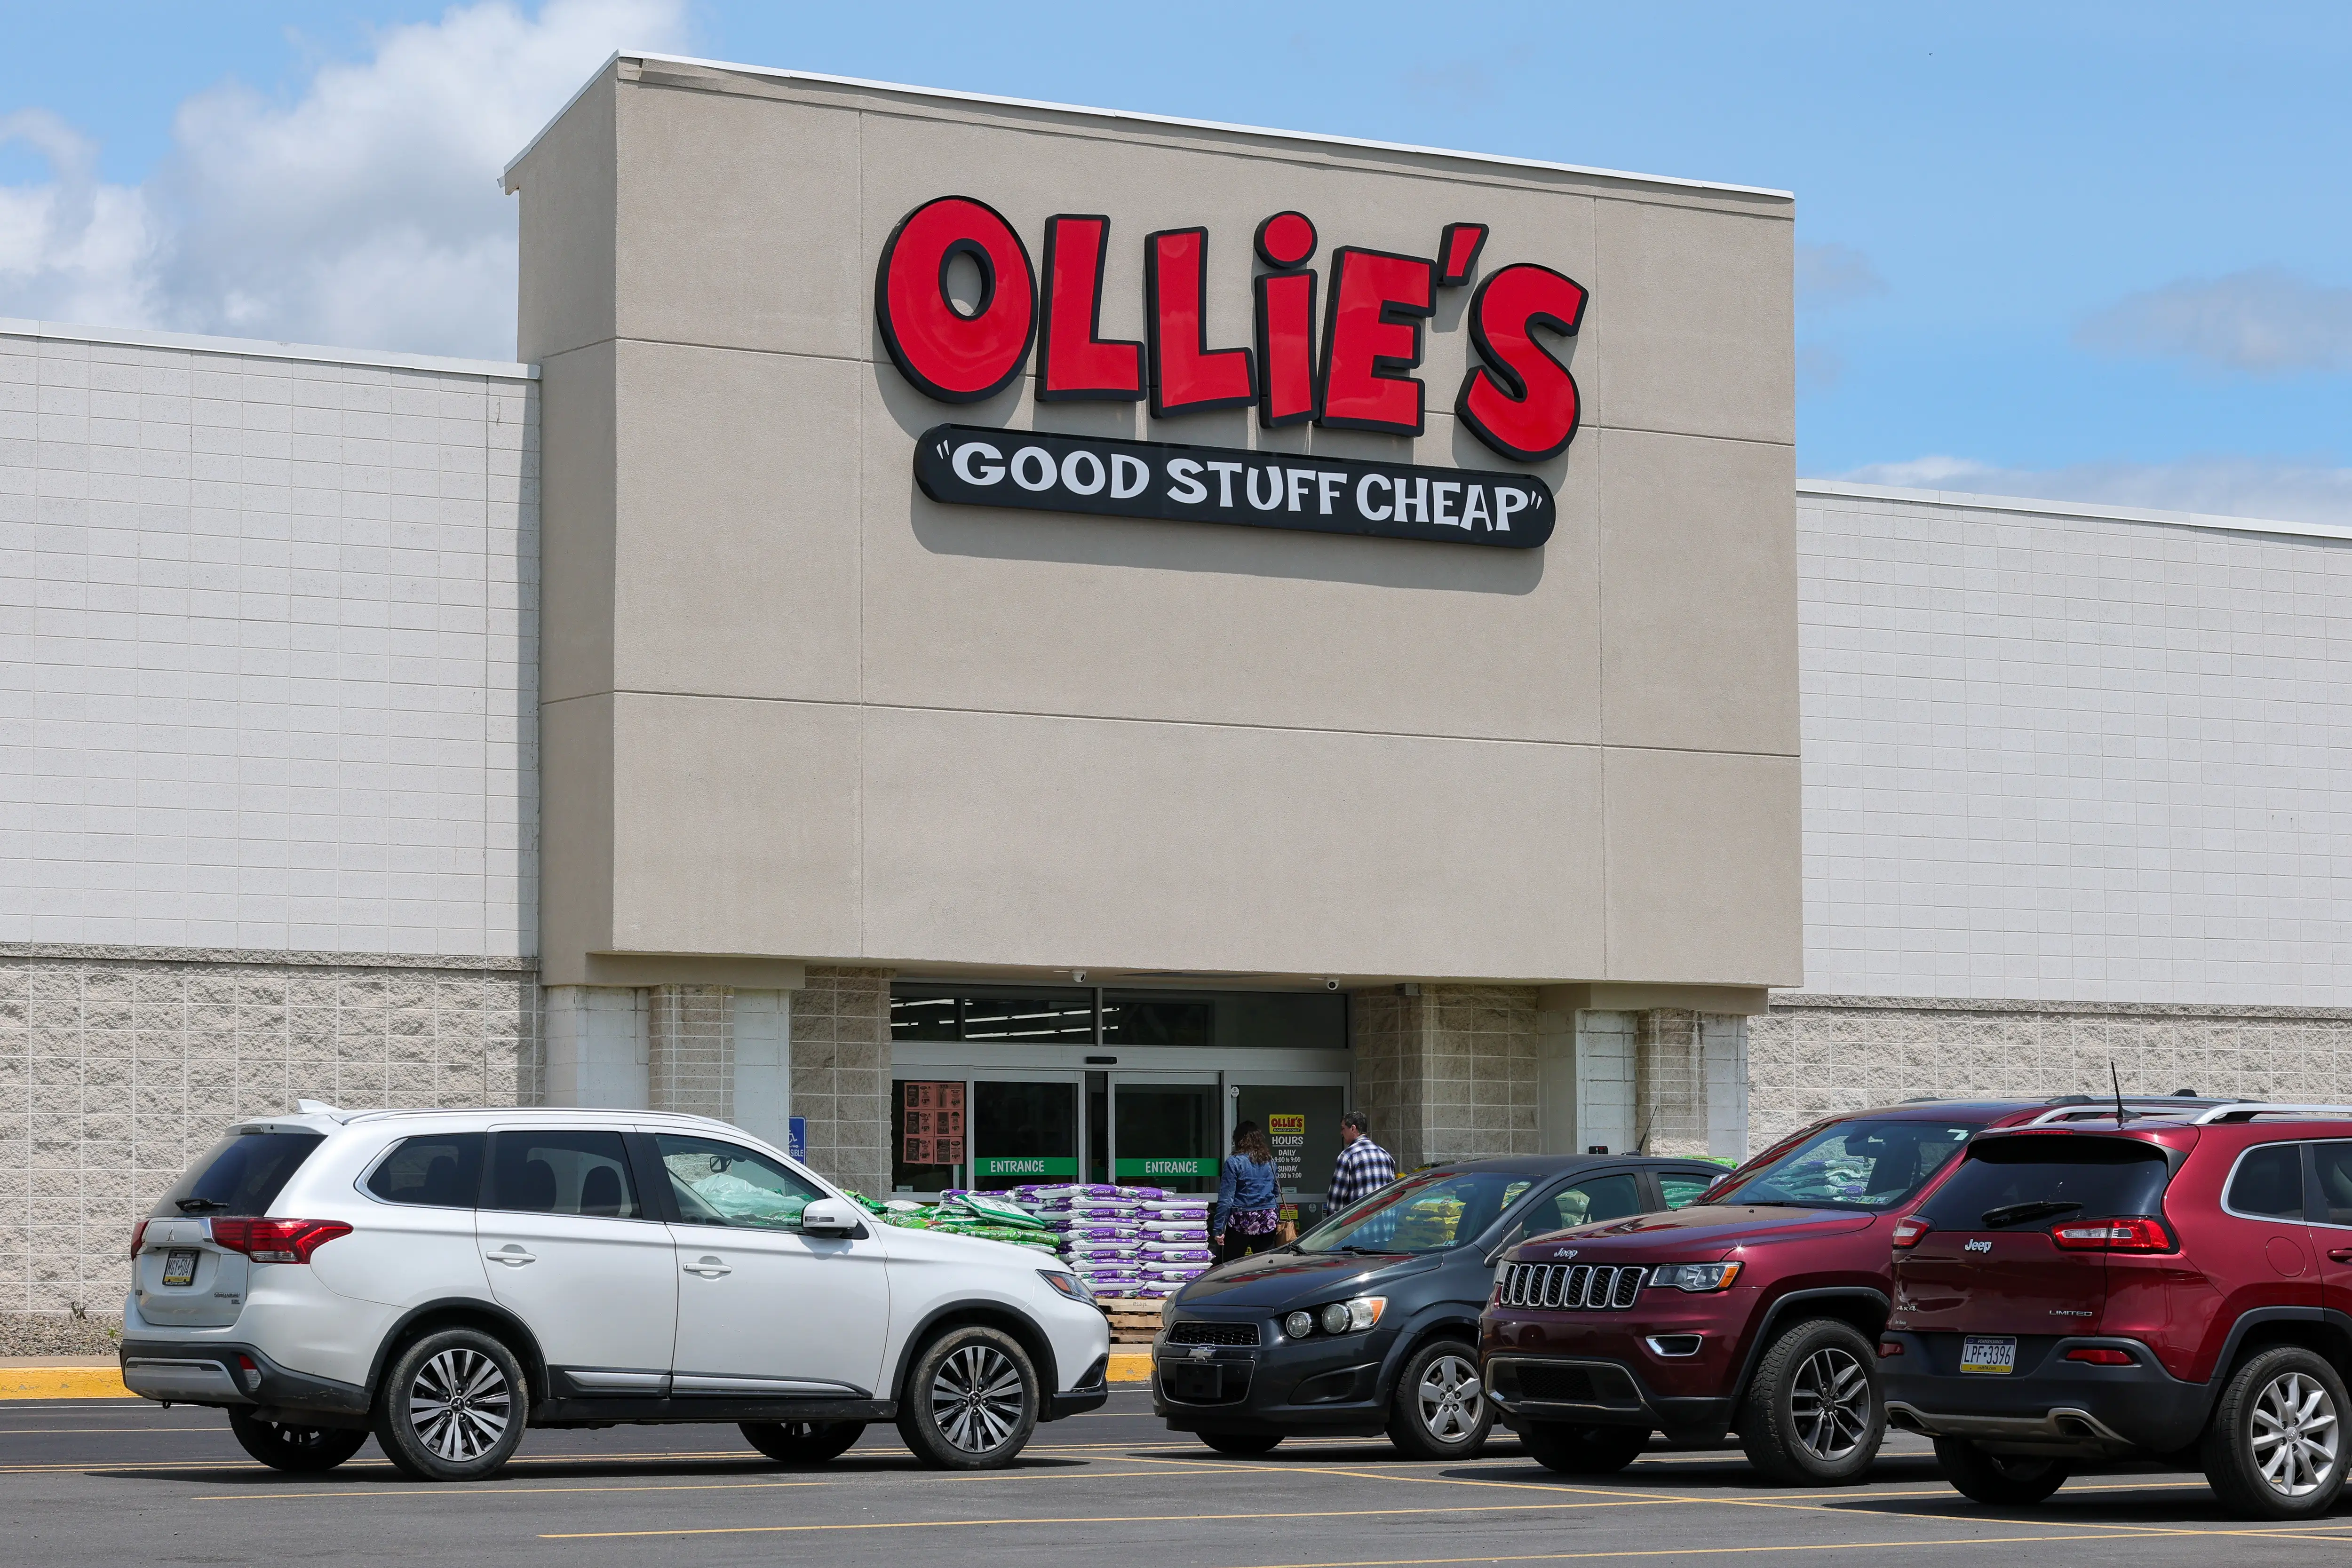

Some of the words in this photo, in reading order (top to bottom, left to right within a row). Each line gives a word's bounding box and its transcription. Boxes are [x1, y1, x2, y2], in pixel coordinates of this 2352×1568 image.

[1166, 458, 1348, 515] STUFF
[1272, 1136, 1303, 1145] HOURS
[990, 1160, 1044, 1172] ENTRANCE
[1145, 1161, 1198, 1173] ENTRANCE
[1964, 1238, 1991, 1253] Jeep
[1554, 1247, 1578, 1259] Jeep
